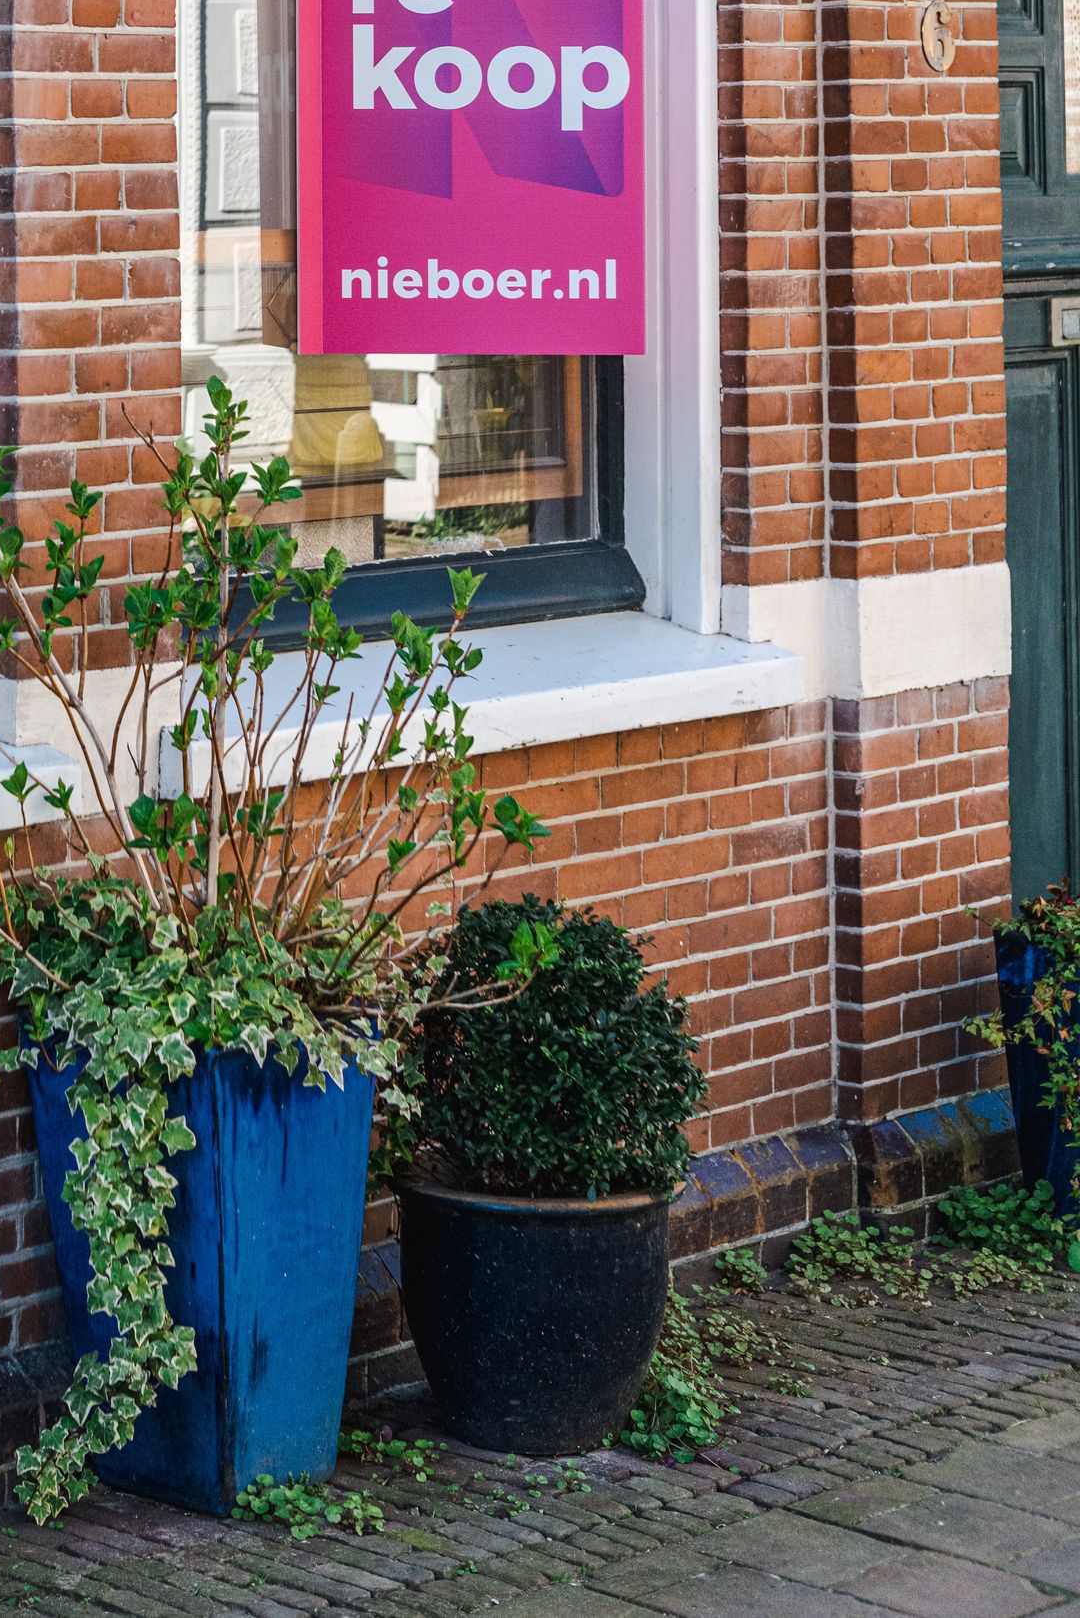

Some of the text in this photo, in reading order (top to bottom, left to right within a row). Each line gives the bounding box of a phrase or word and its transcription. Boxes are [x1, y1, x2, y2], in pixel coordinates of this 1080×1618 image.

[921, 0, 956, 73] 6
[352, 23, 631, 132] koop
[341, 256, 618, 300] nieboer.nl
